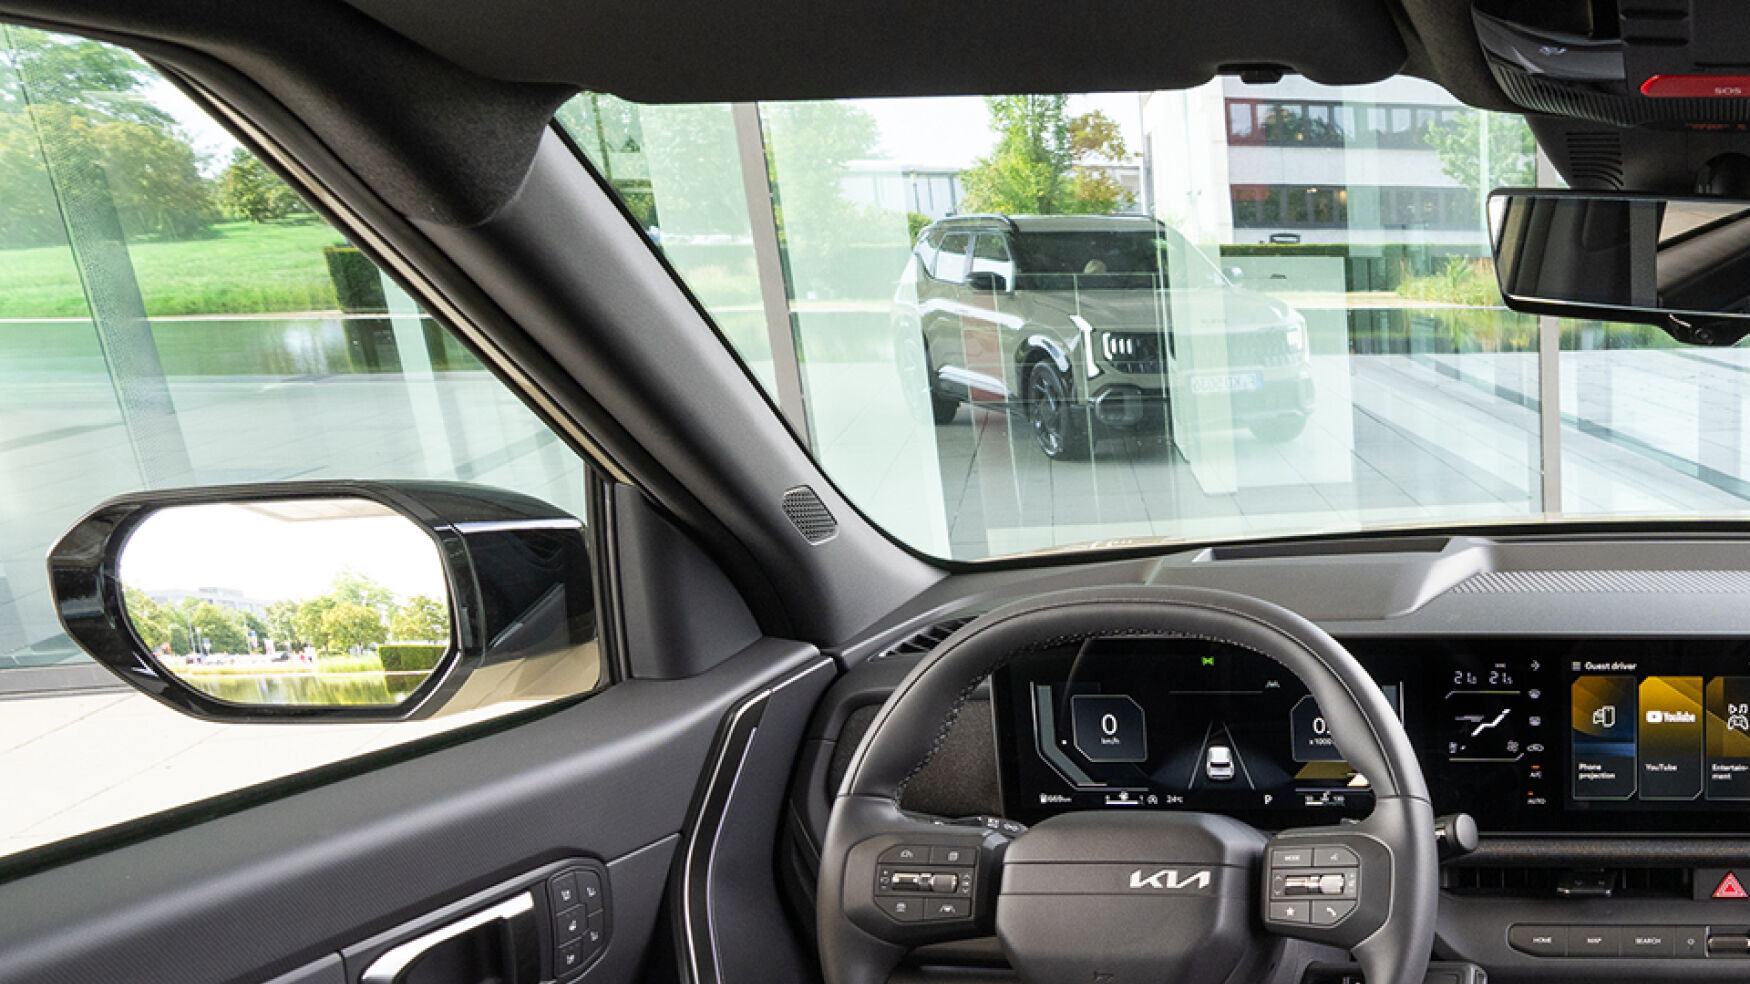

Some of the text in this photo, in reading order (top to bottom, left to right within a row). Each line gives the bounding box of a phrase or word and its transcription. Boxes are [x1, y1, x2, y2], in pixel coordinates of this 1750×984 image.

[1714, 87, 1742, 95] SOS
[1584, 661, 1637, 670] Guest driver
[1102, 713, 1118, 735] 0
[1312, 717, 1331, 734] 0.
[1264, 794, 1273, 805] P
[1130, 870, 1211, 889] KIA
